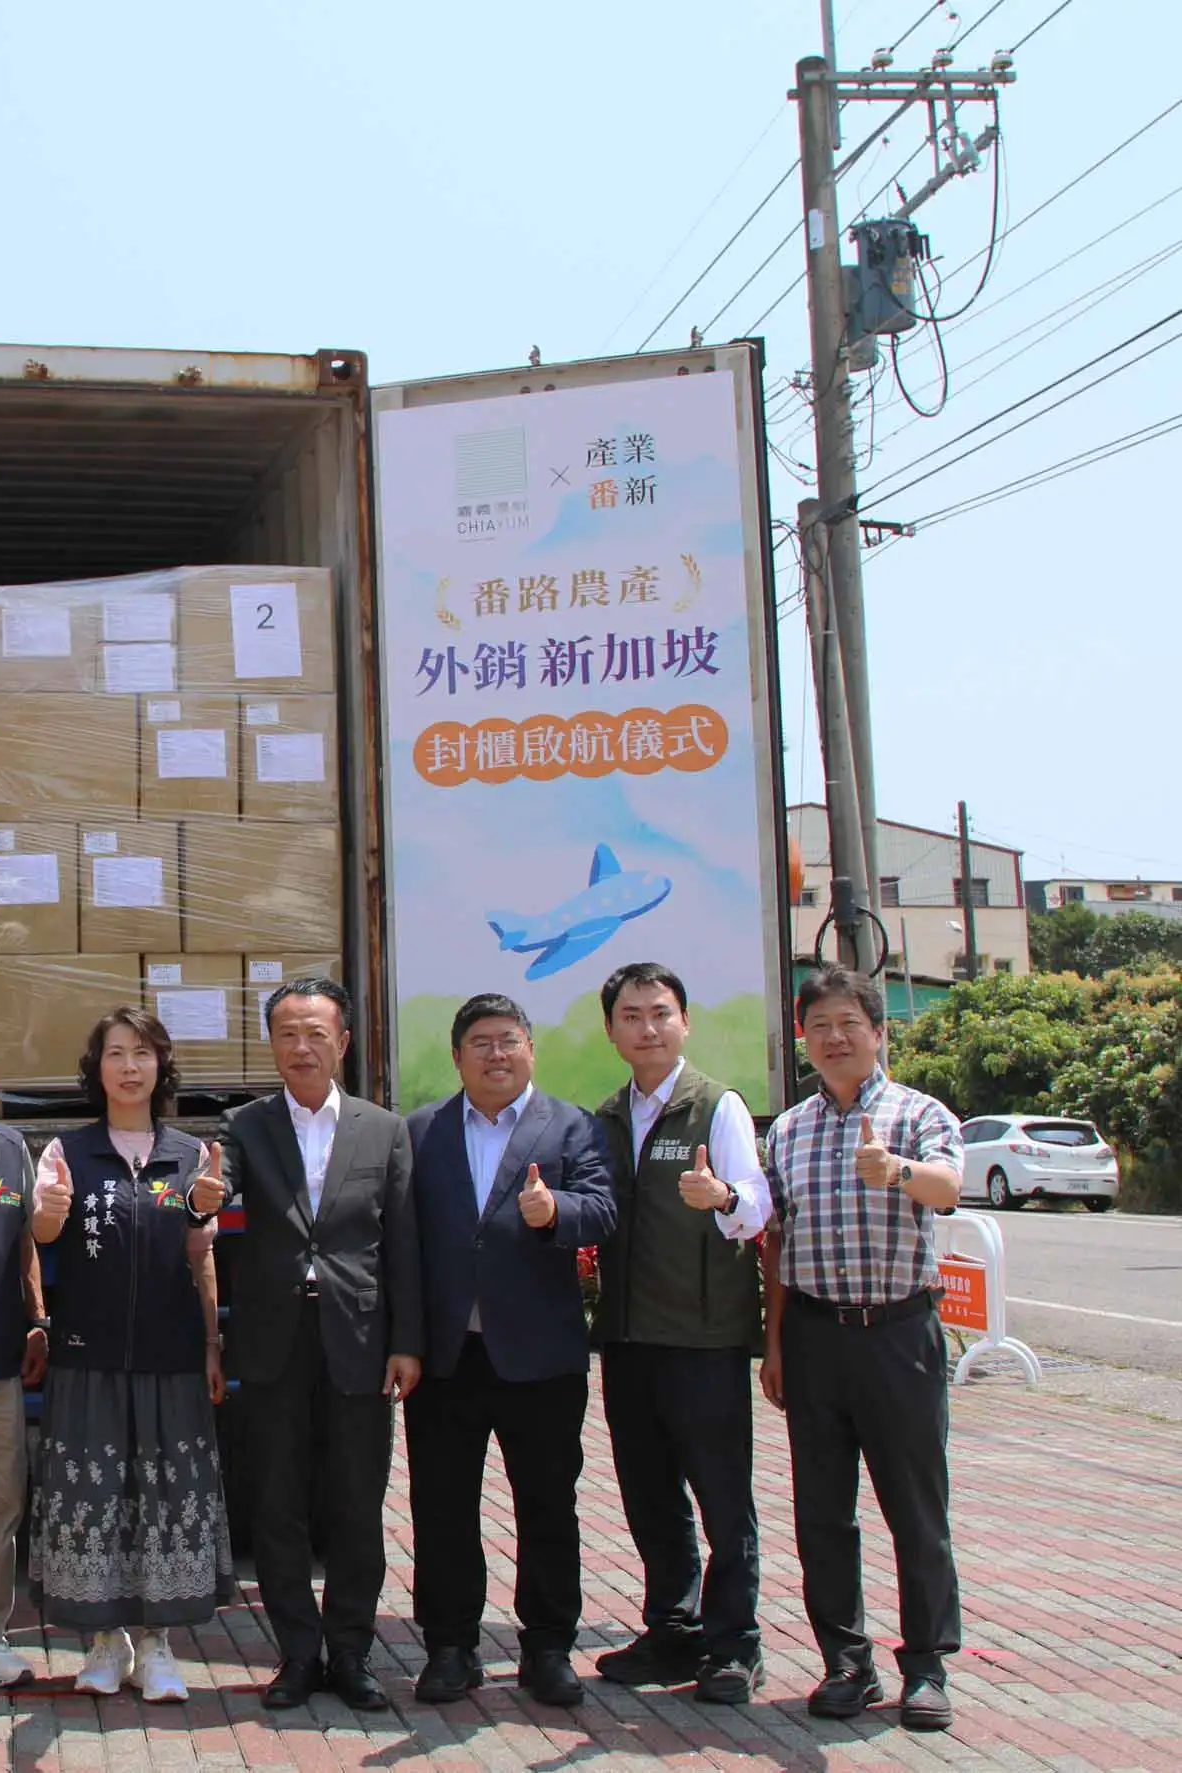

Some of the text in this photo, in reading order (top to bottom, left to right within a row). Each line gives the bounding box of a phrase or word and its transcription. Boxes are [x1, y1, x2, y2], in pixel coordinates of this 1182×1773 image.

[585, 431, 655, 468] 產業
[588, 474, 658, 510] 番新
[470, 565, 661, 617] 番路農產
[257, 603, 275, 629] 2
[415, 626, 720, 696] 外銷新加坡
[425, 715, 715, 775] 封櫃啟航儀式
